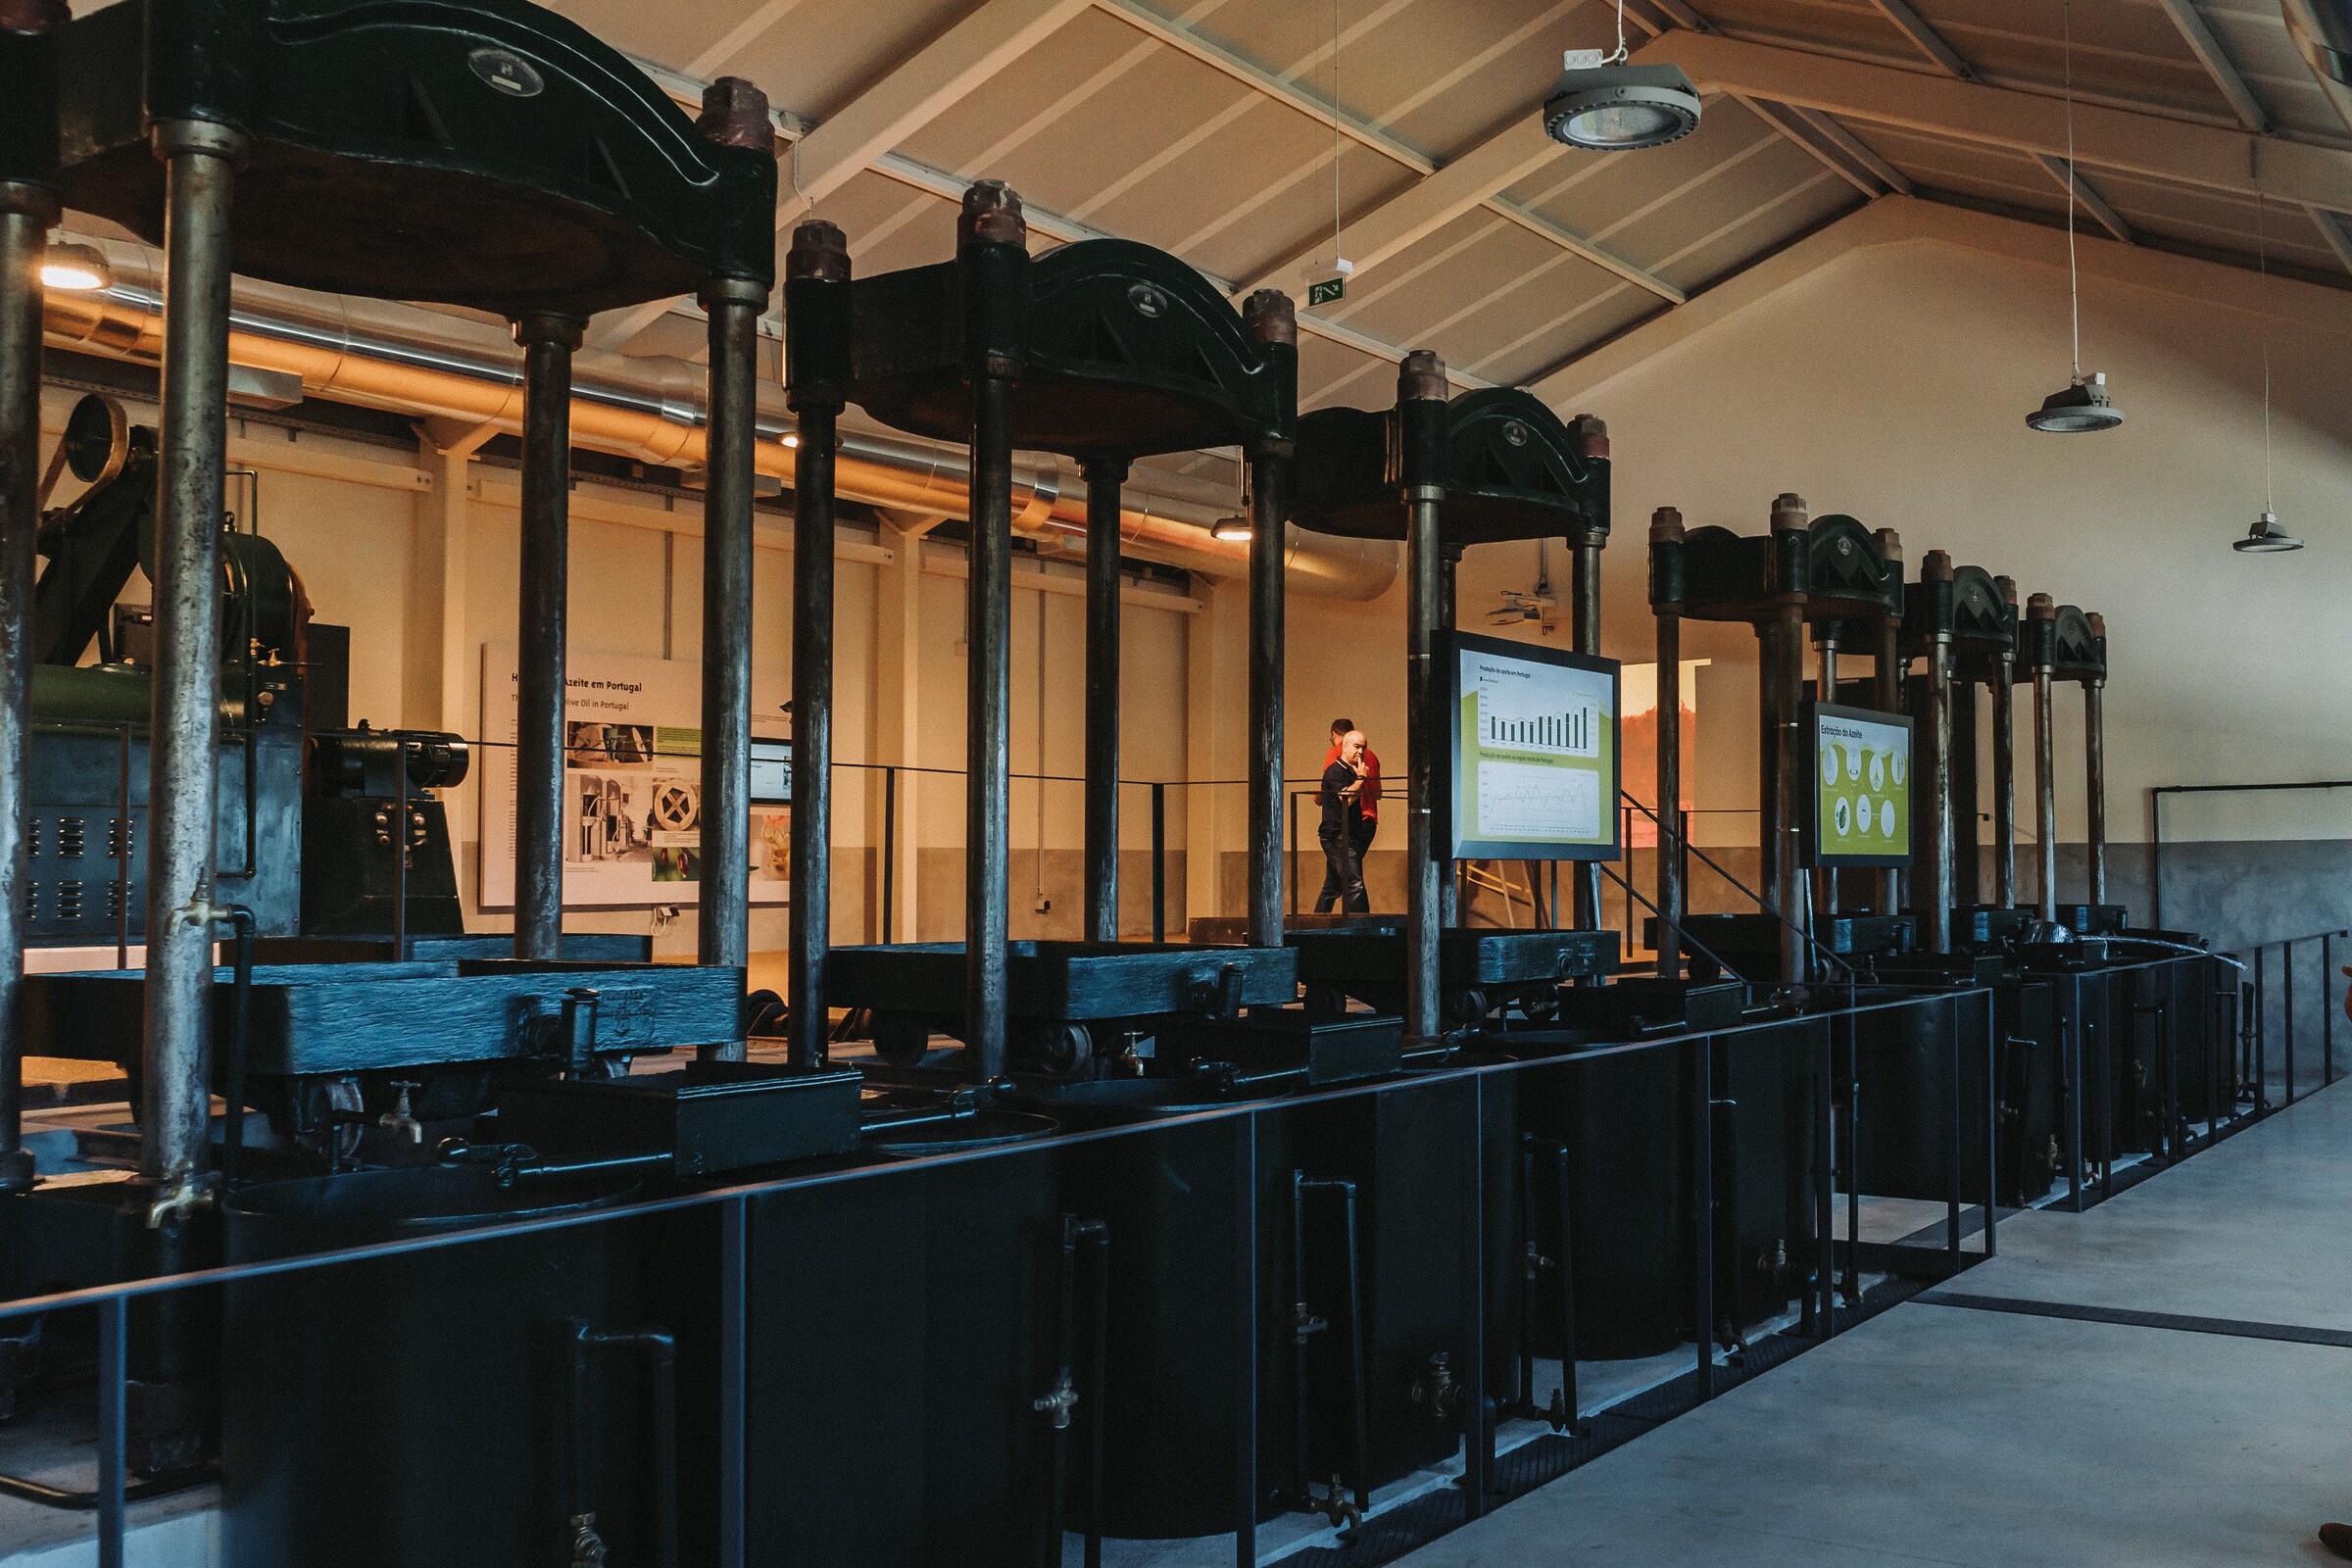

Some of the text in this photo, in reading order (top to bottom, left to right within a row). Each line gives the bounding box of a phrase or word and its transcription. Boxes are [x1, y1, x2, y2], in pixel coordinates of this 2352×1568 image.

[607, 681, 642, 694] Portugal
[565, 698, 579, 707] live
[580, 699, 590, 708] Oil
[600, 701, 629, 712] Portugal
[1842, 728, 1848, 737] do
[1849, 728, 1863, 740] Azeite
